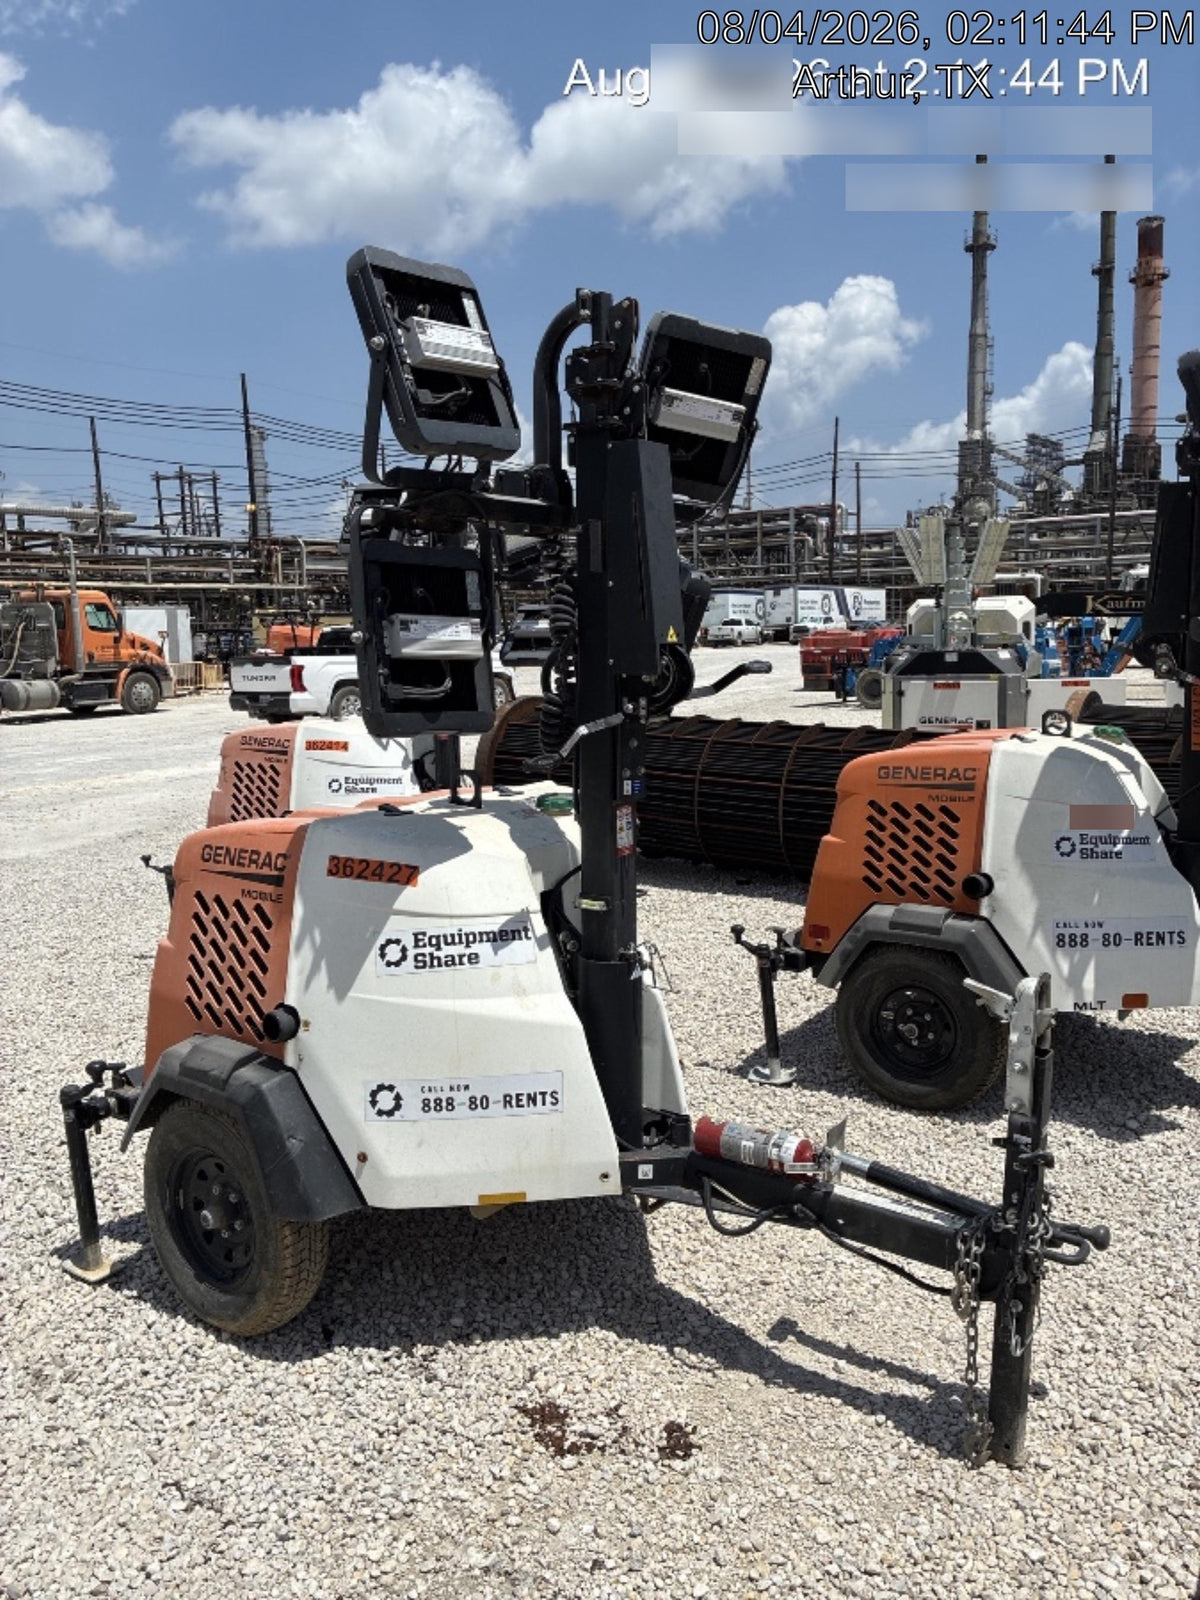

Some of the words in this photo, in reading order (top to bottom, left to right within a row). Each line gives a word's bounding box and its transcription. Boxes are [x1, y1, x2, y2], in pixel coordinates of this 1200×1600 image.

[240, 736, 291, 748] GENERAC
[344, 775, 403, 788] Equipment
[877, 766, 977, 782] GENERAC
[344, 785, 378, 794] Share
[928, 795, 976, 803] MOBILE
[1079, 833, 1151, 850] Equipment
[200, 844, 288, 873] GENERAC
[1079, 847, 1124, 860] Share
[327, 856, 420, 886] 362427
[240, 888, 283, 903] MOBILE
[1055, 921, 1080, 929] CALL
[412, 925, 532, 951] Equipment
[1055, 930, 1187, 949] 888-80-RENTS
[413, 951, 481, 970] Share
[1074, 1001, 1107, 1011] MLT
[421, 1085, 444, 1094] CALL
[449, 1083, 470, 1092] NOW
[421, 1089, 560, 1114] 888-80-RENTS
